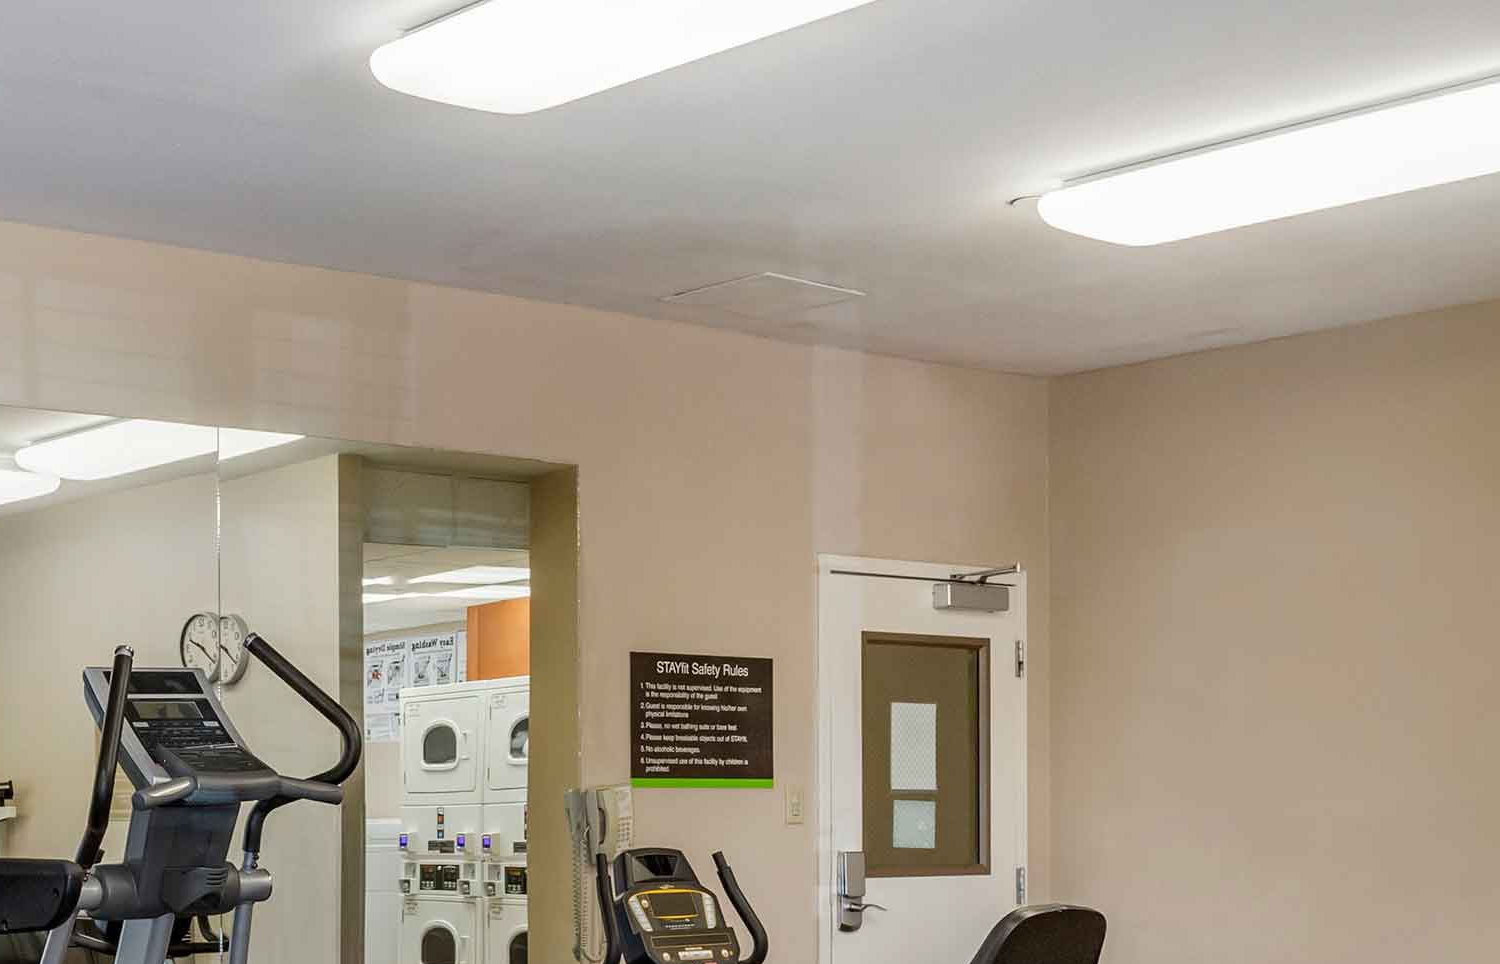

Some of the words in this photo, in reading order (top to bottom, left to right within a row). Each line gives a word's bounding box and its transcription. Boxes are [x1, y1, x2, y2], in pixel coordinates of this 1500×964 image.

[656, 660, 690, 675] STAYfit
[692, 662, 721, 679] Safety
[723, 663, 749, 677] Rules
